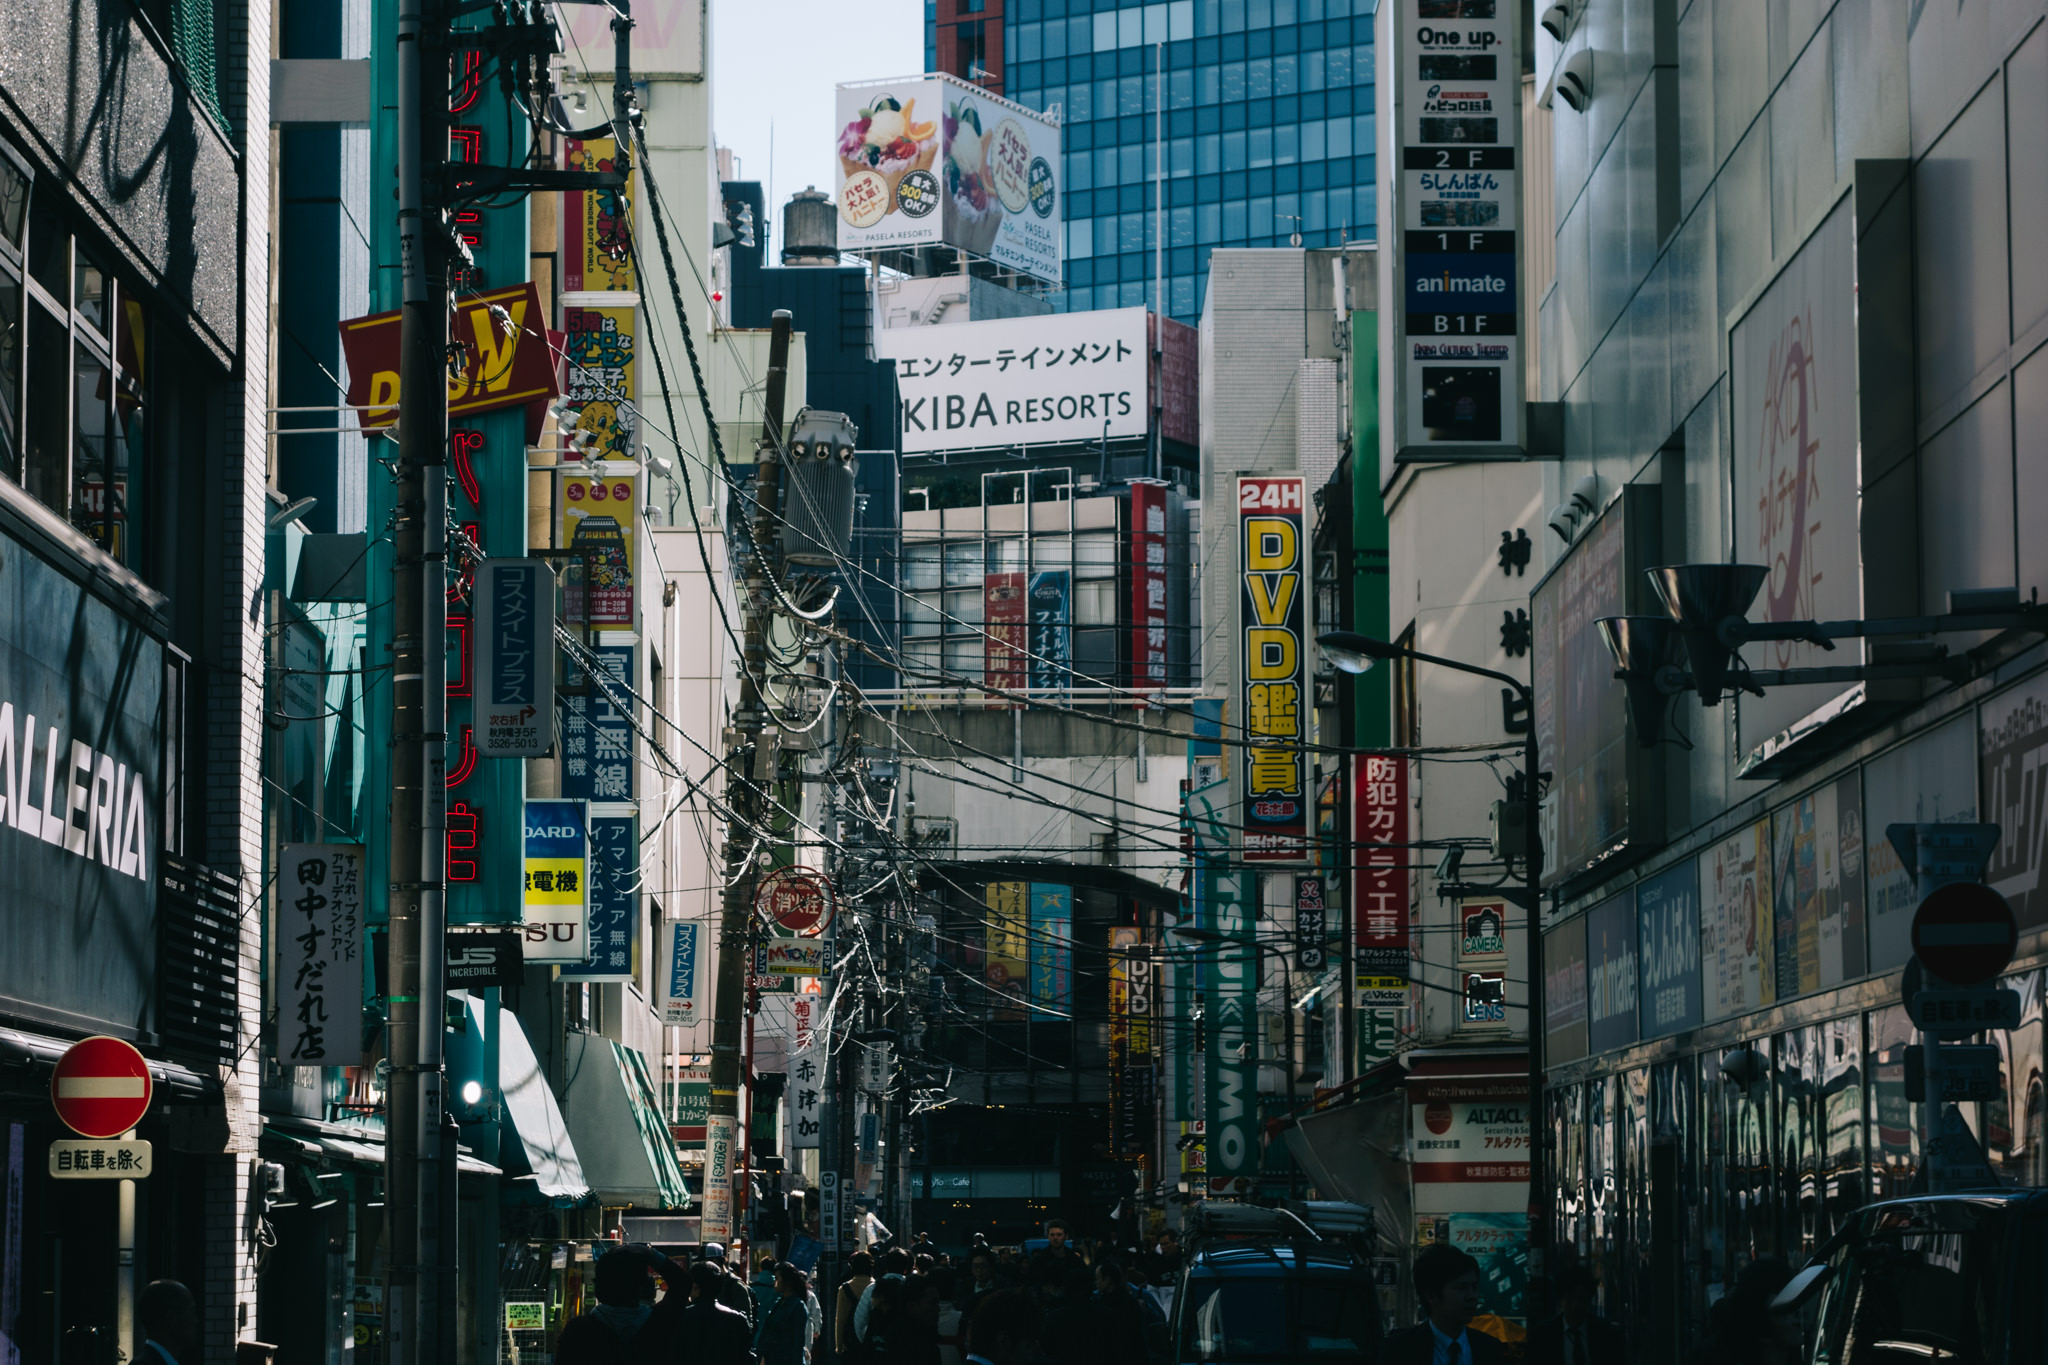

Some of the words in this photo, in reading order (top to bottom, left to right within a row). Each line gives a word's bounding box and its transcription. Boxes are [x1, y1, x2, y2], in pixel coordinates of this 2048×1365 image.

[1418, 27, 1460, 45] One
[1420, 173, 1498, 190] らしんばん
[866, 232, 894, 242] PASELA
[898, 229, 932, 240] RESORTS
[1025, 221, 1050, 240] PASELA
[1025, 236, 1056, 259] RESORTS
[1416, 270, 1507, 293] animate
[568, 332, 633, 350] レトロな
[568, 348, 634, 368] ゲーセン
[899, 340, 1132, 378] エンターテインメント
[569, 366, 625, 388] 駄菓子
[569, 386, 627, 401] もあるよ!
[903, 392, 998, 433] KIBA
[1006, 391, 1132, 424] RESORTS
[1241, 483, 1301, 510] 24H
[500, 568, 529, 702] コスメイトプラス
[490, 715, 519, 726] 次右折
[594, 652, 628, 797] 富士無線
[488, 739, 538, 749] 3526-5013
[489, 728, 537, 738] 秋月電子5F
[1362, 757, 1398, 941] 防犯カメラ・工事
[332, 854, 345, 961] アコーデオンドアー
[344, 854, 358, 961] すだれ・ブラインド
[609, 826, 626, 967] アマチュア無線
[775, 891, 820, 915] 消火栓
[1299, 899, 1323, 911] No.1
[1312, 911, 1324, 946] メイド
[1641, 886, 1697, 990] らしんばん
[1463, 935, 1505, 953] CAMERA
[291, 858, 328, 1060] 田中すだれ店
[674, 924, 693, 998] コスメイトプラス
[1304, 950, 1319, 963] 2F
[450, 967, 497, 978] INCREDIBLE
[1591, 932, 1636, 1024] animate
[1130, 960, 1149, 1014] DVD
[1373, 990, 1404, 999] Victor
[1465, 1001, 1505, 1021] LENS
[796, 1059, 819, 1137] 赤津加
[58, 1149, 142, 1170] 自転車を除く
